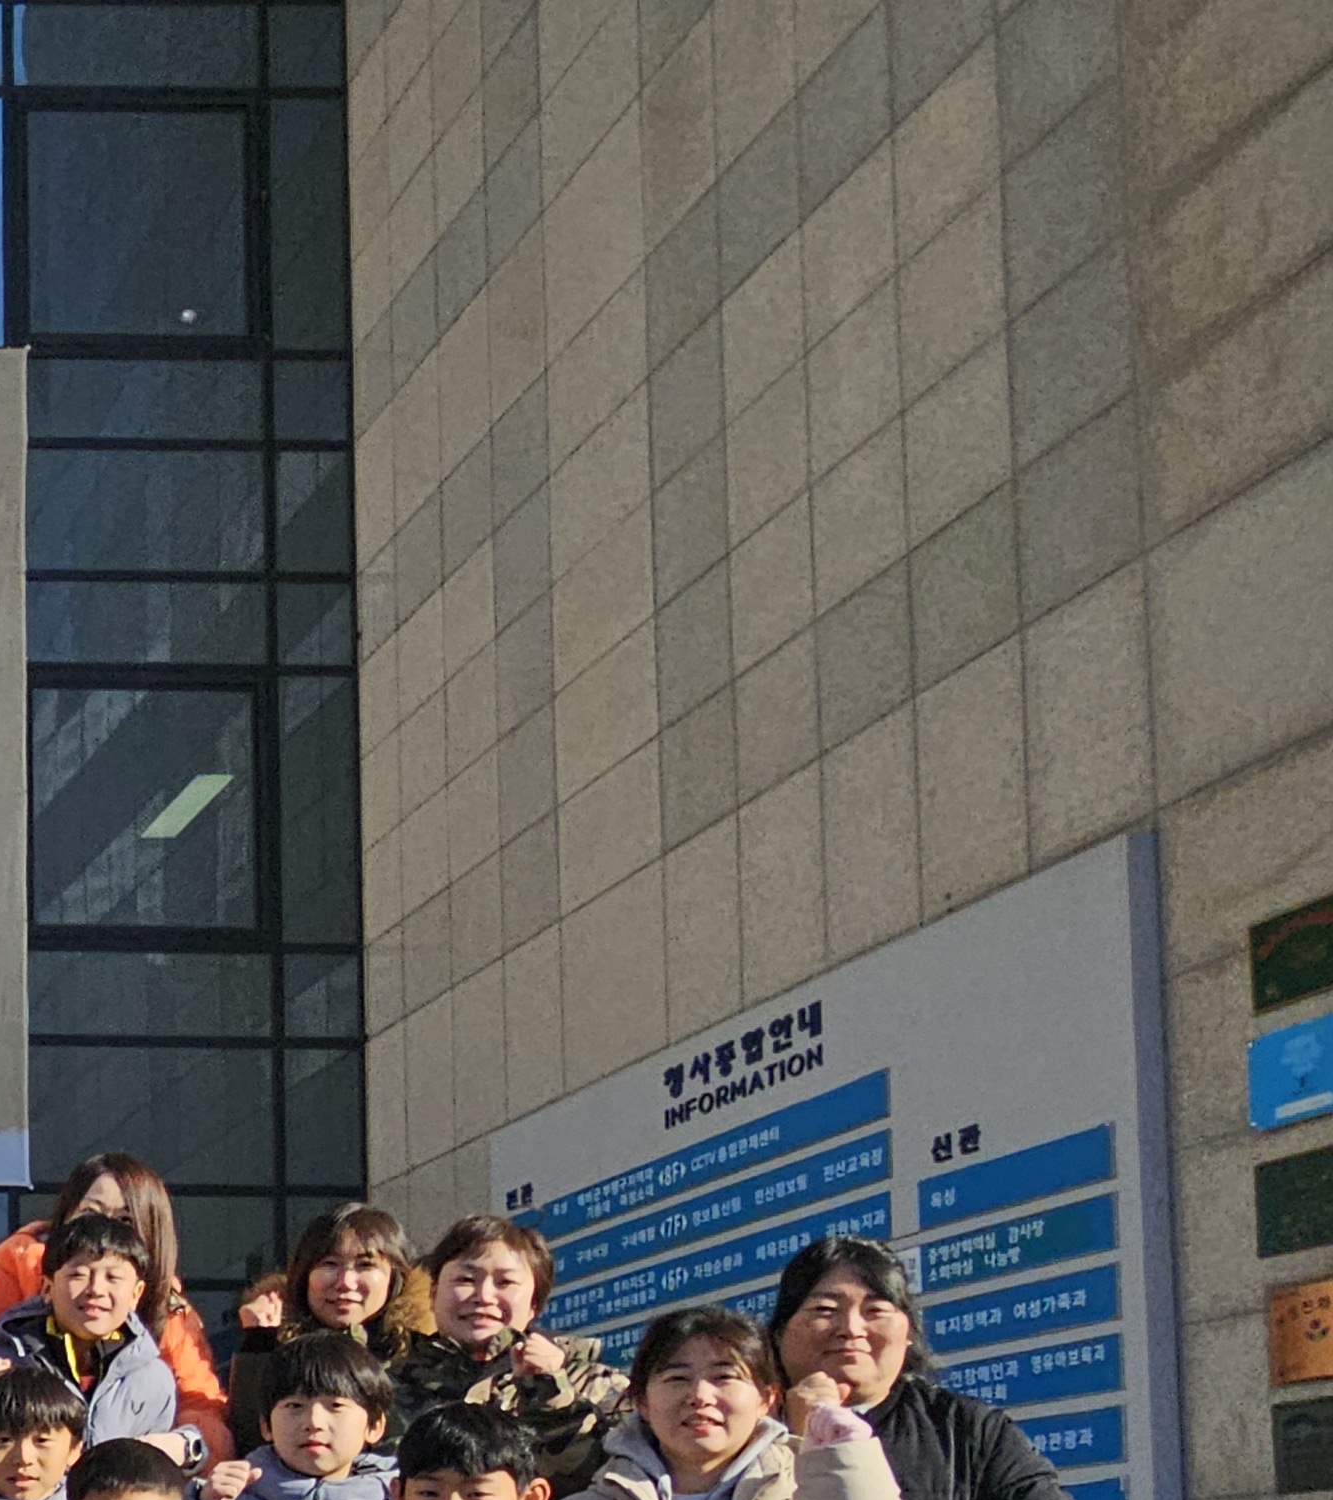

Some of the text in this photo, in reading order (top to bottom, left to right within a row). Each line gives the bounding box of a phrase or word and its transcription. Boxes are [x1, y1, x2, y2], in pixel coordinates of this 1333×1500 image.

[663, 1000, 823, 1098] 청사종합안내
[664, 1043, 824, 1130] INFORMATION
[931, 1123, 981, 1163] 신관
[1012, 1289, 1087, 1319] 여성가족과
